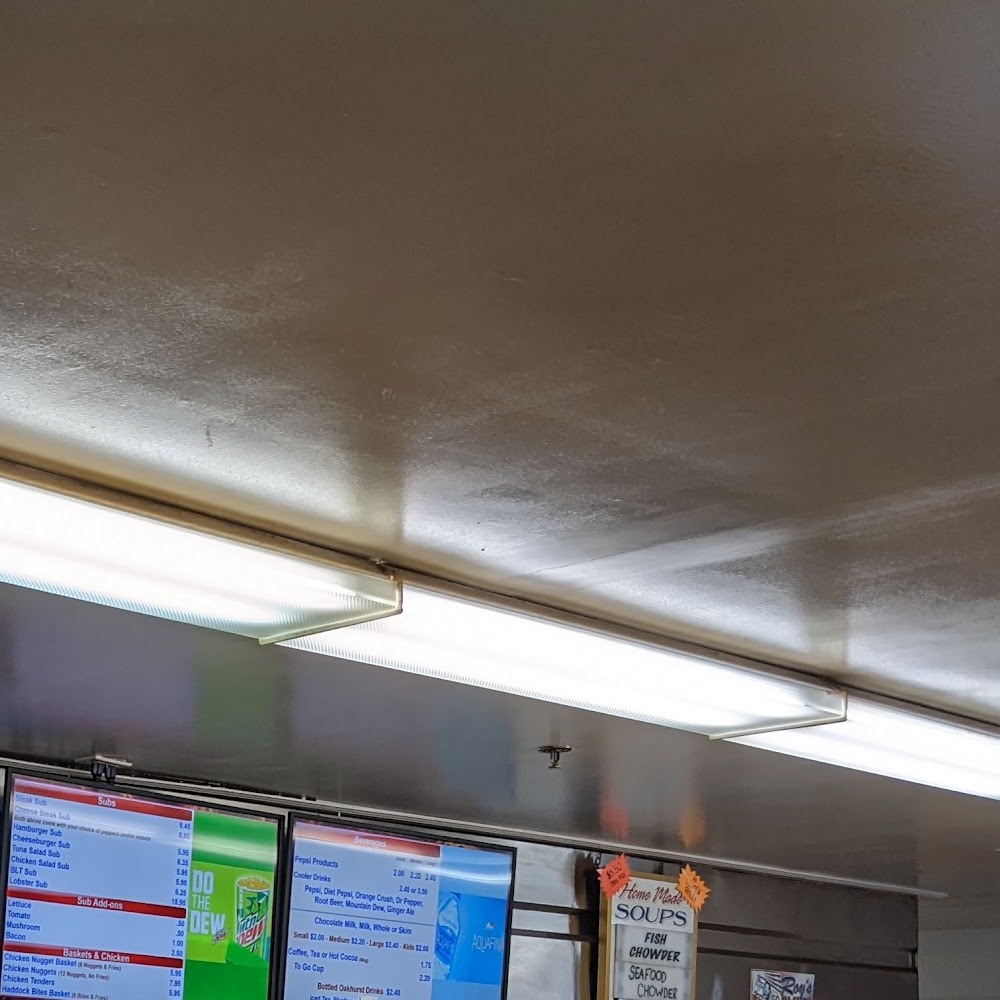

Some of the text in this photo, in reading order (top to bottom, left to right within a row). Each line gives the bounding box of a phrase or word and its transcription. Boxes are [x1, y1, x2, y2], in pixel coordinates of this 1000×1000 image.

[15, 794, 47, 806] Steak Sub
[97, 796, 116, 807] Subs
[14, 805, 71, 821] Cheese Steak Sub
[13, 823, 62, 837] Hamburger Sub
[12, 834, 71, 849] Cheeseburger Sub
[354, 835, 387, 849] Beverages
[12, 844, 61, 858] Tuna Salad Sub
[11, 855, 70, 870] Chicken Salad Sub
[294, 855, 339, 868] Pepsi Products
[10, 866, 38, 877] BLT Sub
[293, 871, 331, 882] Cooler Drinks
[9, 877, 48, 888] Lobster Sub
[192, 869, 214, 895] DO
[304, 884, 424, 908] Pepsi, Diet Pepsi, Orange Crush, Dr Pepper,
[619, 882, 651, 901] Home
[652, 886, 683, 905] Made
[8, 900, 32, 909] Lettuce
[77, 896, 123, 910] Sub Add-ons
[191, 894, 211, 911] THE
[314, 896, 415, 916] Root Beer, Mountain Dew, Ginger Ale
[8, 910, 31, 920] Tomato
[615, 903, 687, 927] SOUPS
[6, 921, 41, 932] Mushroom
[189, 909, 226, 936] DEW
[314, 916, 412, 935] Chocolate Milk, Milk, Whole Skim
[5, 931, 26, 941] Bacon
[293, 931, 415, 951] Small Medium Large Kids
[644, 932, 668, 945] FISH
[3, 953, 77, 967] Chicken Nugget Basket
[63, 948, 130, 963] Baskets & Chicken
[288, 947, 309, 958] Coffee,
[310, 949, 321, 958] Tea
[328, 951, 339, 960] Hot
[340, 953, 359, 962] Cocoa
[629, 946, 681, 962] CHOWDER
[3, 964, 57, 976] Chicken Nuggets
[294, 962, 325, 974] To Go Cup
[628, 964, 667, 984] SEAFOOD
[2, 975, 55, 986] Chicken Tenders
[781, 976, 812, 998] Roy's
[2, 985, 71, 998] Haddock Bites Basket
[317, 982, 384, 995] Bottled Oakhurst Drinks
[637, 982, 678, 1000] CHOWDER
